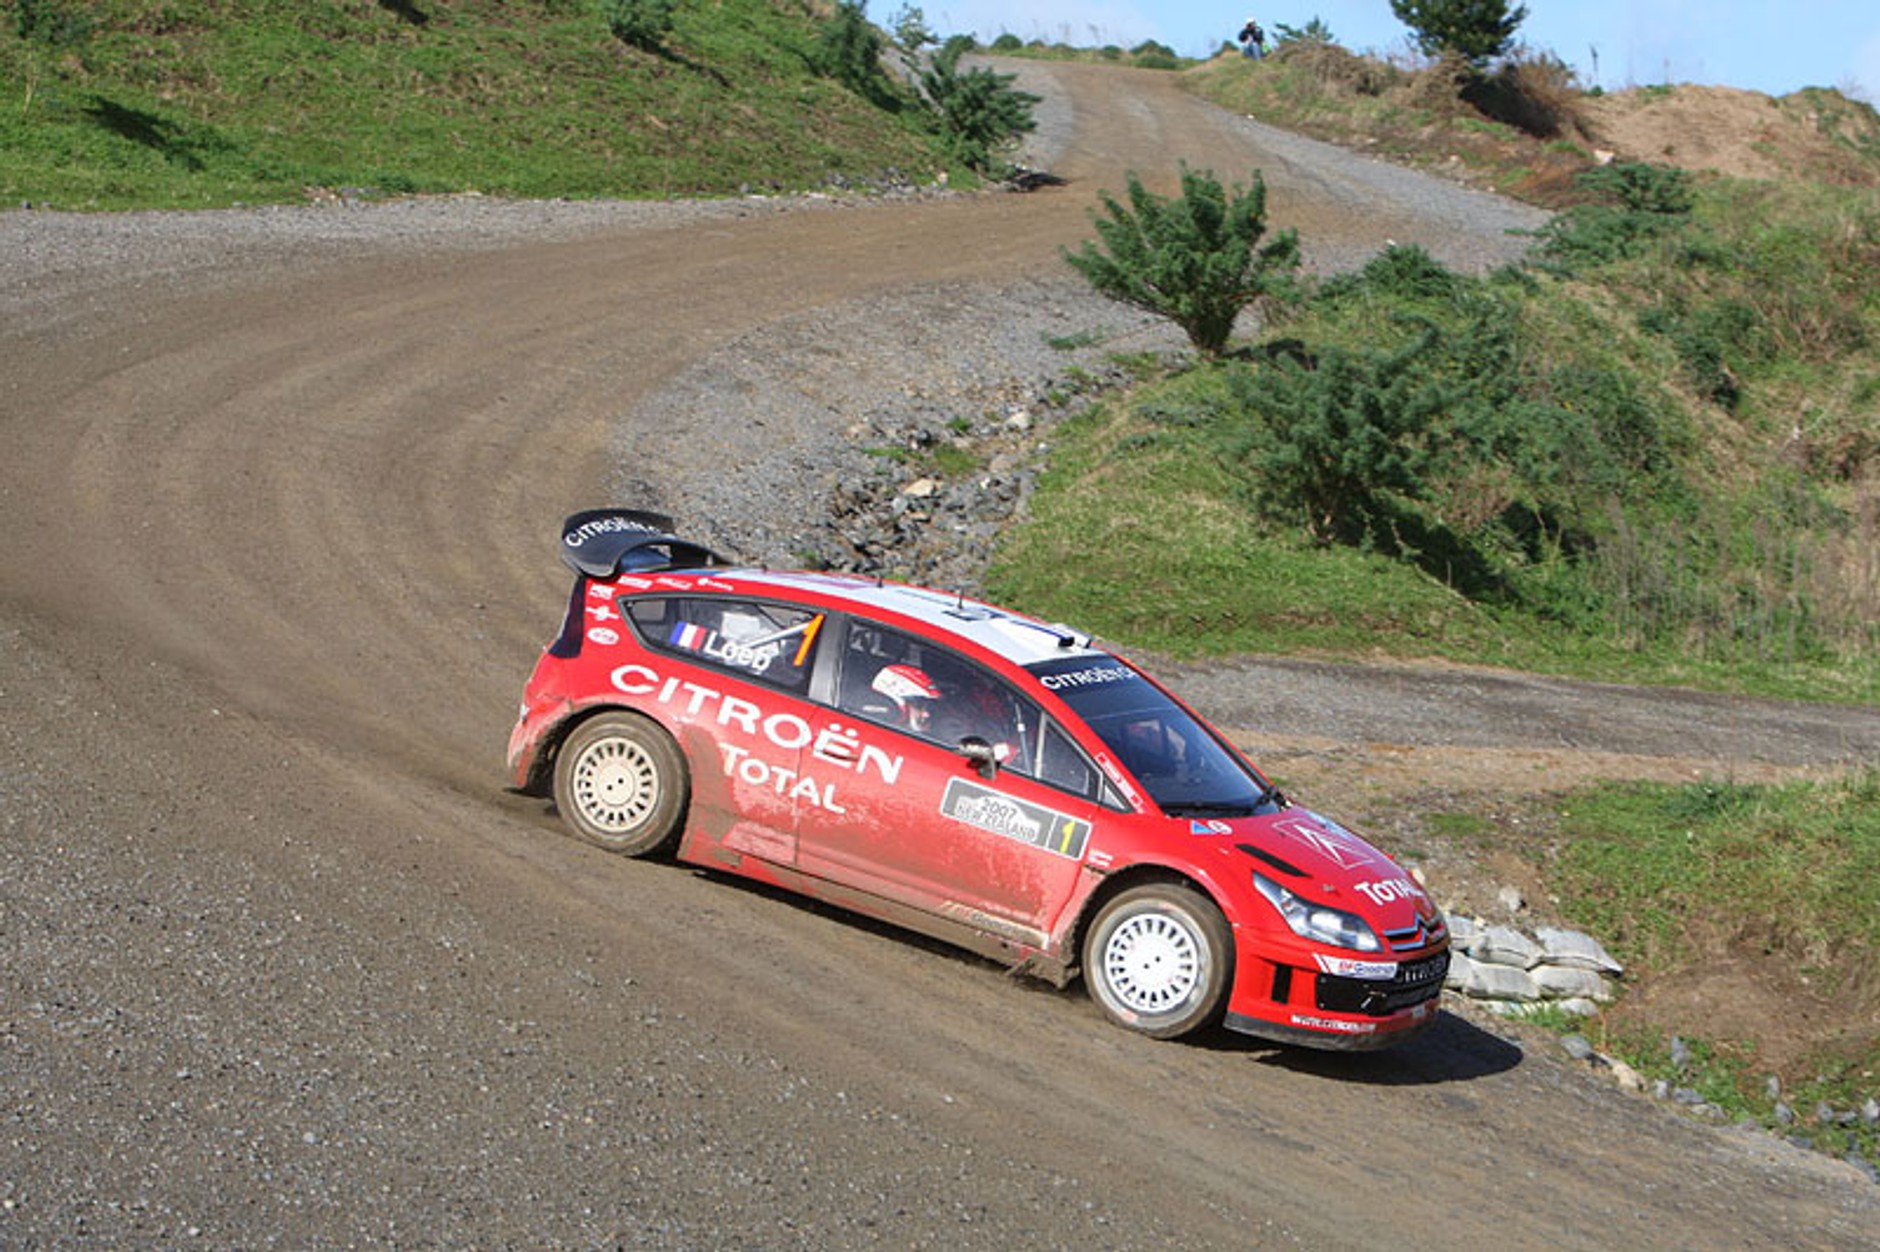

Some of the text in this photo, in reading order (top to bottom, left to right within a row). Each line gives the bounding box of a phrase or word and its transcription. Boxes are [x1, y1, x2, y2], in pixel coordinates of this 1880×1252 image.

[703, 631, 772, 671] Loeb
[793, 613, 825, 667] 1
[610, 664, 904, 785] CITROËN
[718, 742, 847, 815] TOTAL
[955, 803, 1036, 840] NEW ZEALAND
[980, 797, 1017, 820] 2007
[1059, 819, 1077, 854] 1
[1353, 877, 1424, 906] TOTAL
